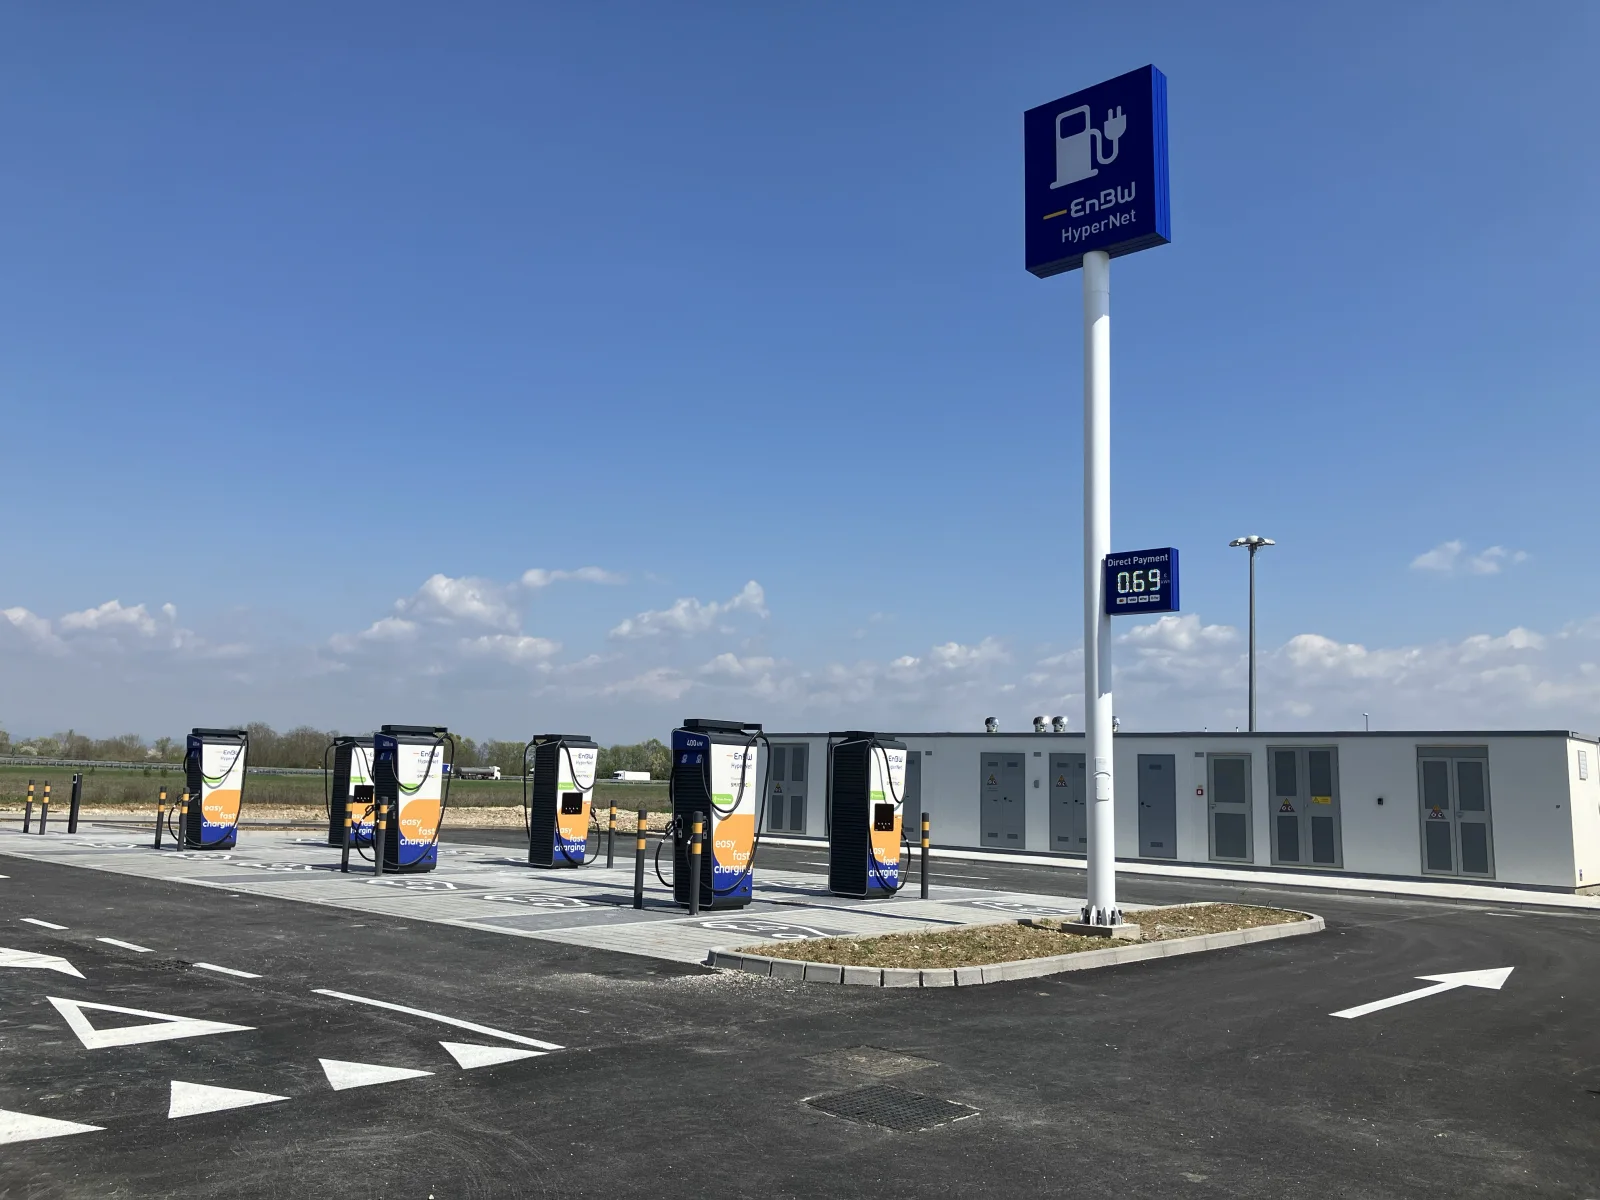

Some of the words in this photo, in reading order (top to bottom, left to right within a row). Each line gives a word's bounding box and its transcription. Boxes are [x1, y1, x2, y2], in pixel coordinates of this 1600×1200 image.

[1070, 181, 1136, 218] EnBW
[1061, 209, 1137, 243] HyperNet
[1107, 557, 1132, 567] Direct
[1133, 553, 1169, 565] Payment
[1117, 569, 1161, 593] 0.69
[686, 739, 697, 747] 400
[733, 752, 753, 761] EnW
[219, 811, 237, 820] fast
[401, 818, 422, 827] easy
[418, 827, 436, 836] fast
[570, 834, 584, 842] fast
[715, 839, 736, 850] easy
[733, 849, 750, 861] fast
[882, 856, 897, 866] fast
